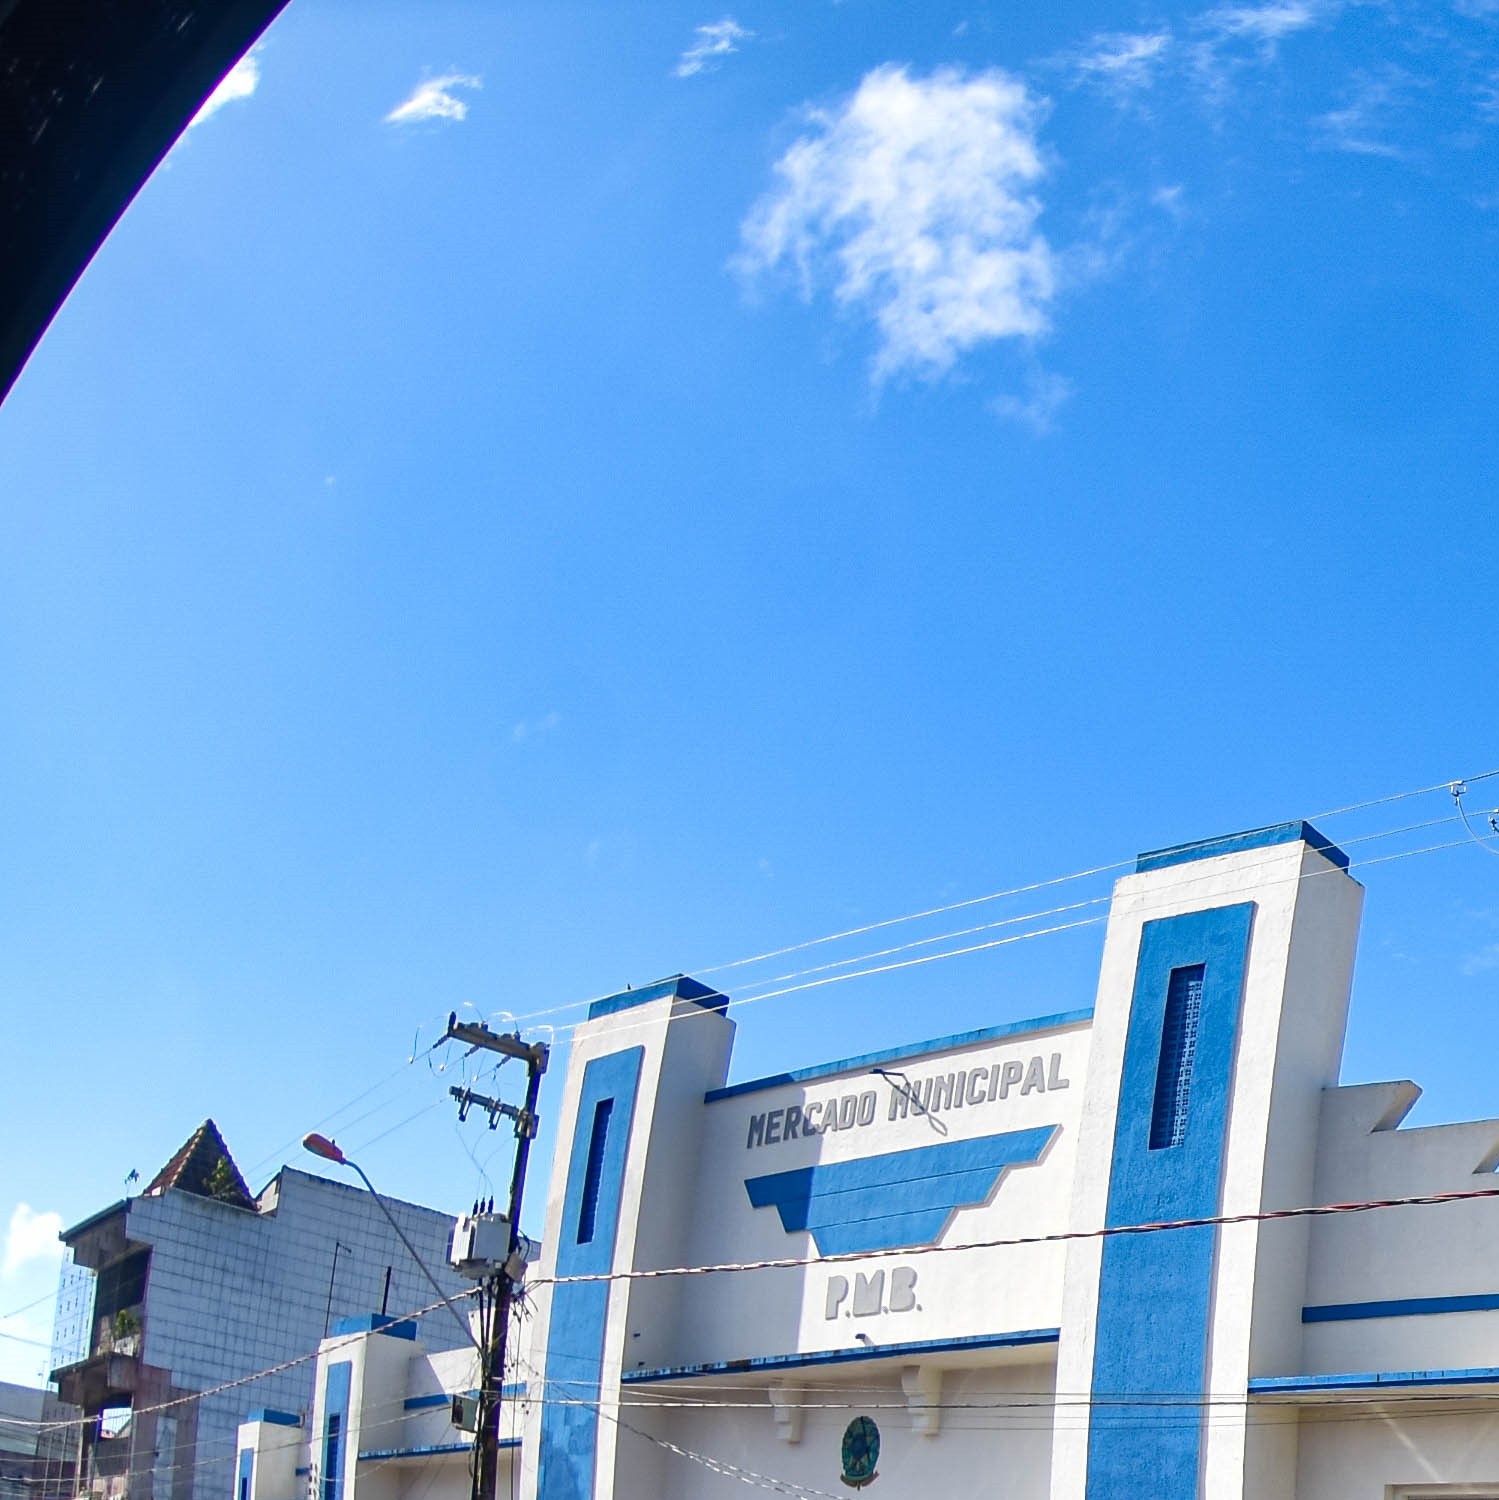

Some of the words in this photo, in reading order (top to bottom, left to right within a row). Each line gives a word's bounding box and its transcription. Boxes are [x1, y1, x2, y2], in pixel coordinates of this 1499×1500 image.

[746, 1090, 877, 1149] MERCADO
[888, 1053, 1070, 1121] MUNICIPAL
[825, 1266, 923, 1320] P.M.B.
